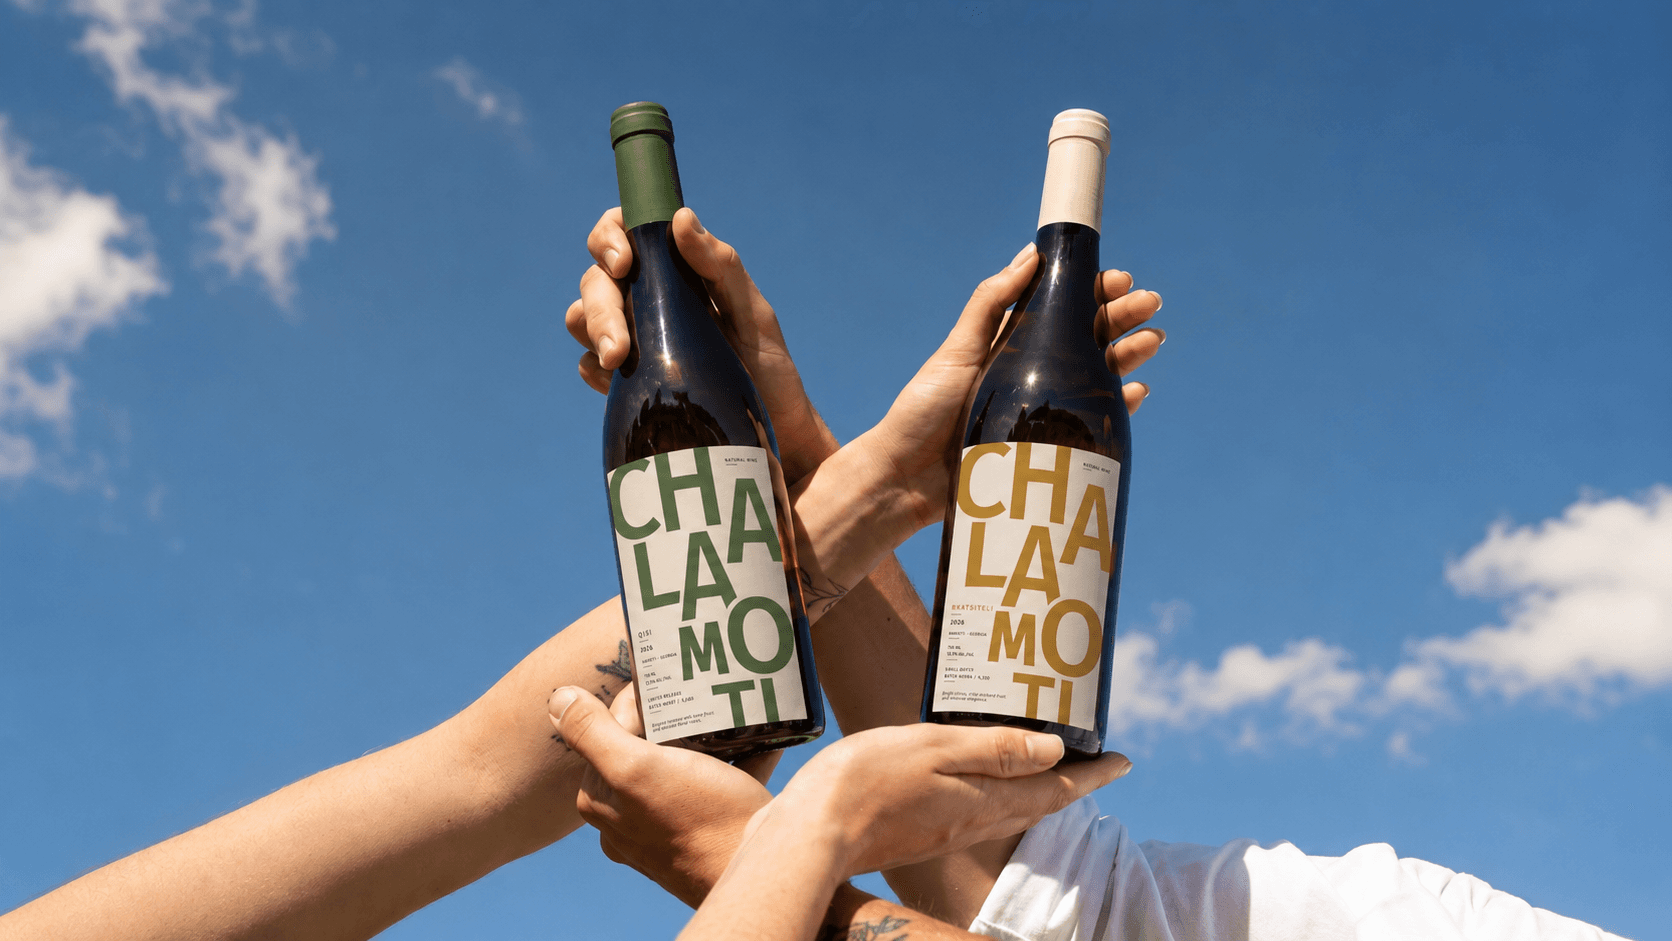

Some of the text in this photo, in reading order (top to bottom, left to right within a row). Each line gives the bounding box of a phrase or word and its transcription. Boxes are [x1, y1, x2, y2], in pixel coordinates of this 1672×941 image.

[633, 531, 737, 622] LA
[965, 522, 1060, 608] LA
[678, 596, 794, 681] MO
[988, 599, 1102, 678] MO
[711, 678, 780, 728] TI
[1013, 673, 1073, 725] TI
